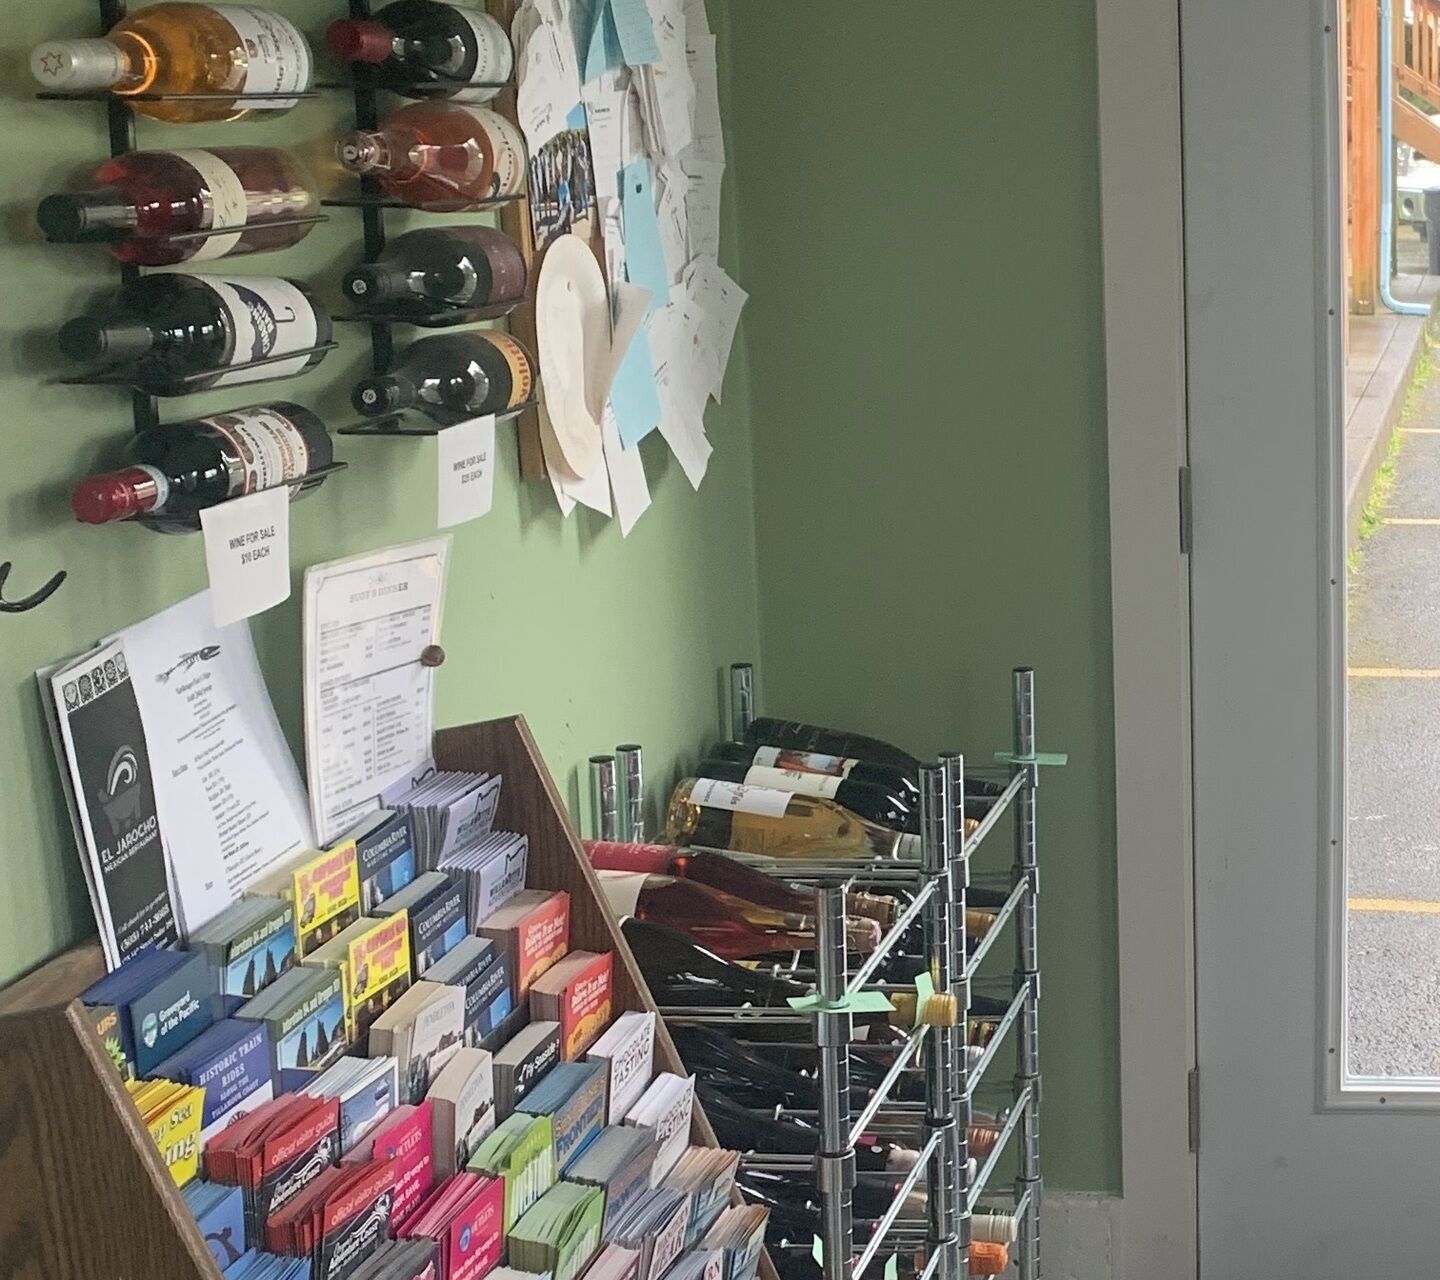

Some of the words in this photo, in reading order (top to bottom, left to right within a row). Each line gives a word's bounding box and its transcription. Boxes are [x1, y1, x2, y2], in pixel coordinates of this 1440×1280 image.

[466, 456, 476, 468] FOR
[477, 452, 487, 464] SALE
[470, 470, 483, 482] EACH
[229, 534, 246, 550] WINE
[246, 531, 260, 545] FOR
[260, 526, 275, 541] SALE
[252, 546, 270, 562] EACH
[378, 581, 408, 597] DINNER
[101, 849, 114, 864] EL
[115, 815, 157, 856] JAROCHO
[104, 852, 129, 874] MEXICAN
[418, 906, 446, 935] COLUMBIA
[445, 893, 461, 916] RIVER
[159, 990, 191, 1021] Graveyard
[160, 1023, 168, 1036] of
[168, 1015, 179, 1031] the
[179, 999, 200, 1023] Pacific
[200, 1051, 238, 1085] HISTORIC
[239, 1032, 264, 1059] TRAIN
[222, 1063, 245, 1087] RIDES
[613, 1037, 651, 1089] TASTING
[272, 1141, 295, 1166] official
[295, 1126, 316, 1150] visitor
[315, 1111, 335, 1138] guide
[268, 1179, 302, 1211] Adventure
[301, 1166, 325, 1191] Coast
[331, 1201, 354, 1227] official
[354, 1185, 375, 1209] visitor
[374, 1169, 395, 1195] guide
[328, 1238, 361, 1272] Adventure
[360, 1224, 379, 1248] Coast
